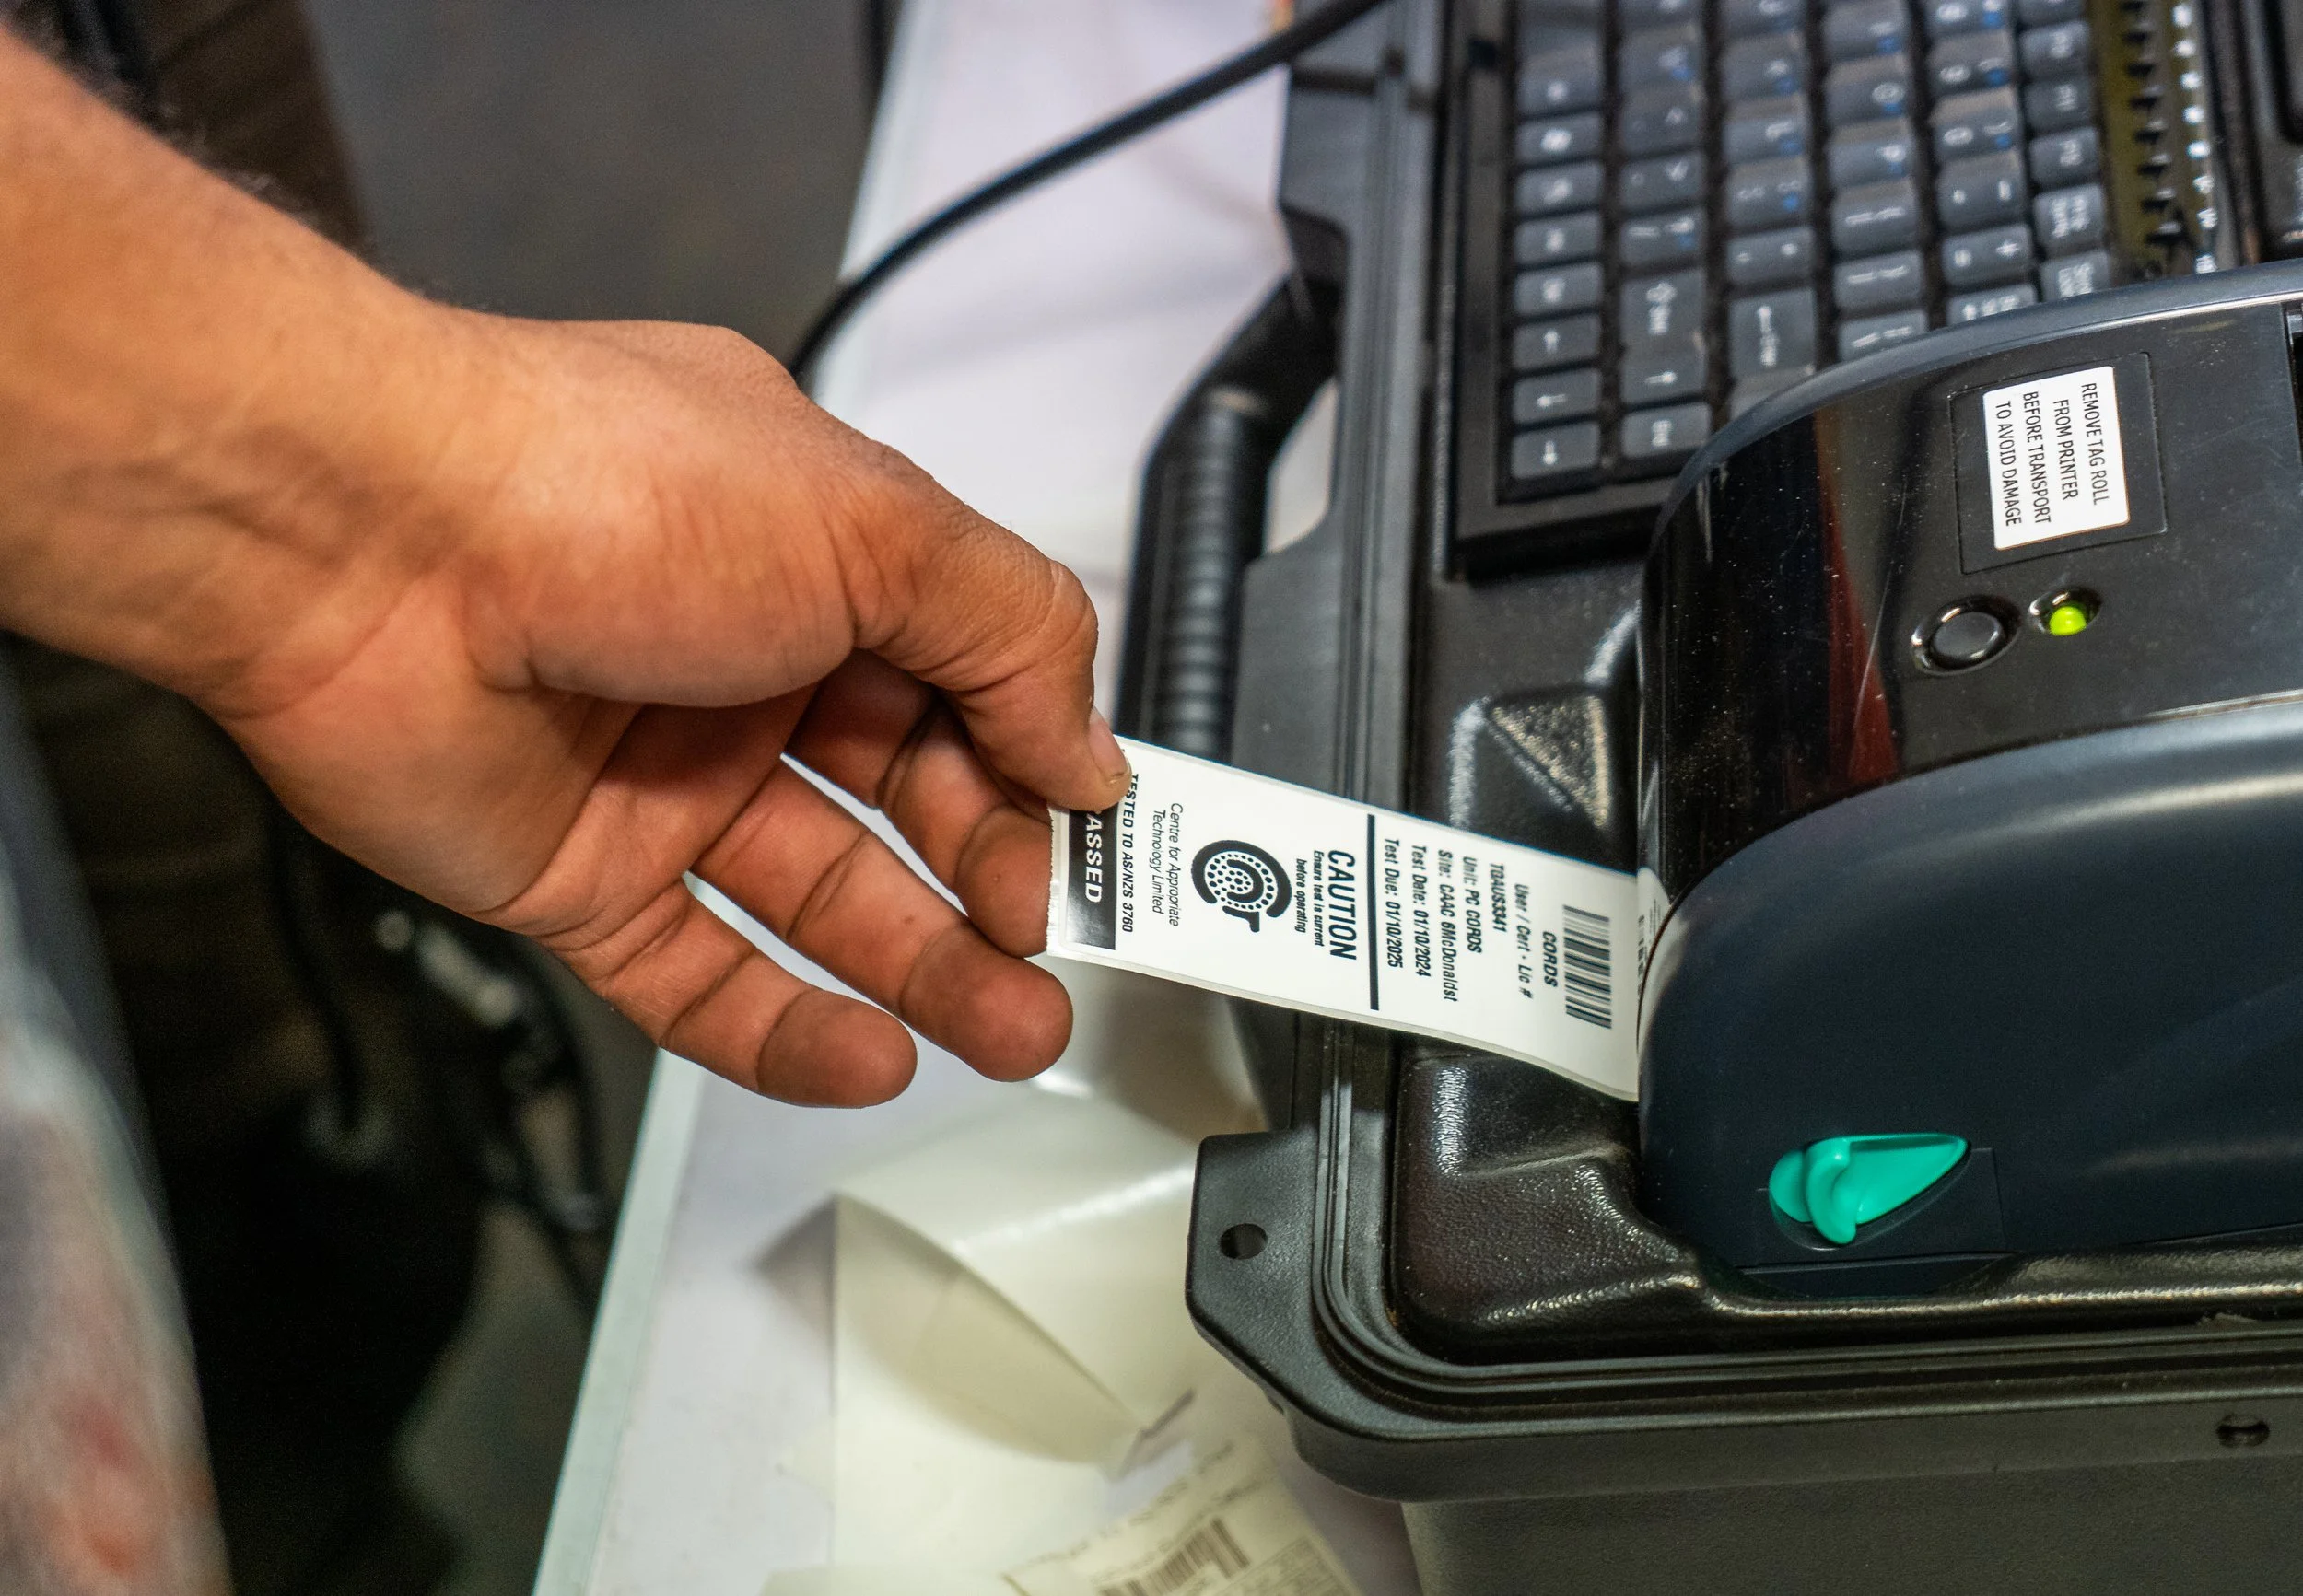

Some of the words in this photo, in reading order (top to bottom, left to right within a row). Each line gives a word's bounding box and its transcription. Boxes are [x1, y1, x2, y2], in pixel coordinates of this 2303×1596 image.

[1995, 400, 2012, 420] TO
[2023, 391, 2043, 443] BEFORE
[2053, 399, 2073, 438] FROM
[2081, 382, 2103, 437] REMOVE
[1997, 424, 2017, 466] AVOID
[2087, 439, 2106, 467] TAG
[2028, 444, 2052, 524] TRANSPORT
[2057, 440, 2079, 500] PRINTER
[2090, 469, 2110, 506] ROLL
[2002, 468, 2022, 527] DAMAGE
[1122, 832, 1134, 848] TO
[1149, 810, 1166, 870] Technology
[1168, 803, 1184, 844] Centre
[1085, 814, 1103, 903] ASSED
[1168, 847, 1179, 862] for
[1314, 850, 1325, 881] Ensure
[1385, 838, 1400, 865] Test
[1411, 845, 1427, 870] Test
[1438, 849, 1453, 877] Site:
[1122, 852, 1134, 898] AS/NZS
[1296, 858, 1307, 886] before
[1385, 868, 1400, 896] Due:
[1463, 856, 1477, 886] Unit:
[1151, 872, 1164, 914] Limited
[1165, 865, 1182, 926] Appropriate
[1314, 884, 1325, 901] test
[1327, 850, 1357, 960] CAUTION
[1412, 874, 1428, 906] Date:
[1439, 883, 1455, 917] CAAC
[1465, 889, 1480, 906] PC
[1514, 883, 1529, 912] User
[1121, 902, 1134, 933] 3760
[1294, 890, 1307, 933] operating
[1314, 903, 1325, 913] is
[1314, 915, 1325, 946] current
[1385, 901, 1404, 969] 01/10/2025
[1413, 909, 1432, 977] 01/10/2024
[1466, 909, 1482, 954] CORDS
[1516, 925, 1531, 953] Cert
[1441, 921, 1458, 1002] 6McDonaldst
[1517, 964, 1533, 984] Lic
[1542, 931, 1558, 988] CORDS
